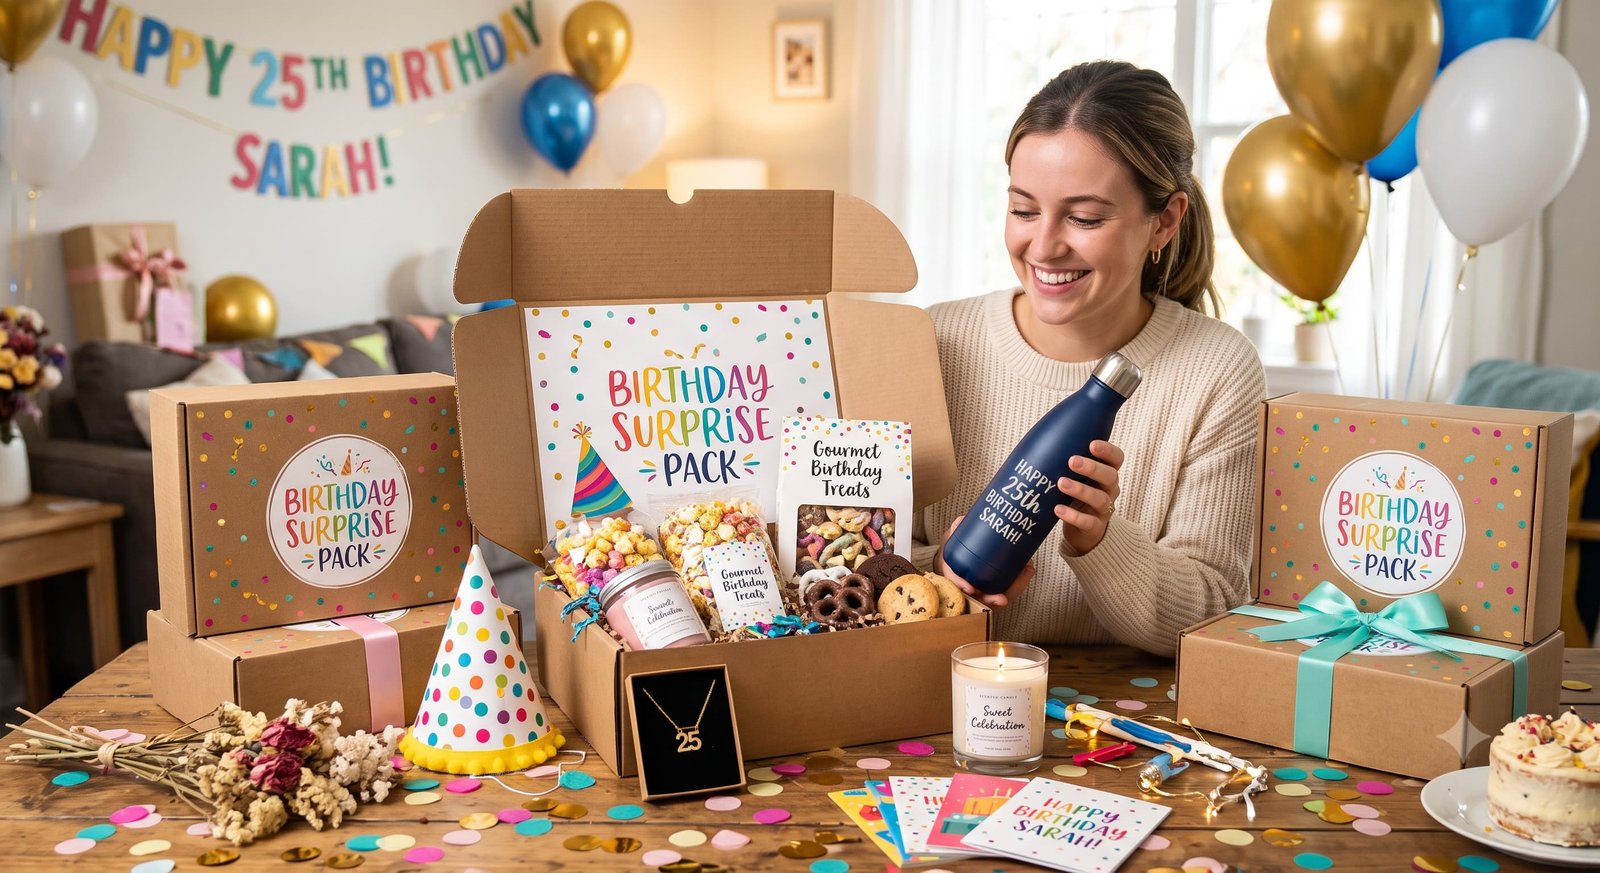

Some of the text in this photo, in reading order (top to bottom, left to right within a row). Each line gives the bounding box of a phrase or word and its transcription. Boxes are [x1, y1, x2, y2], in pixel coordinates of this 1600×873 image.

[57, 0, 543, 110] HAPPY 25TH BIRTHDAY
[230, 133, 396, 199] SARAH!
[608, 363, 774, 407] BIRTHDAY
[813, 439, 882, 460] Gourmet
[664, 449, 741, 487] PACK
[811, 460, 883, 485] Birthday
[1014, 458, 1056, 494] HAPPY
[284, 478, 400, 516] BIRTHDAY
[821, 479, 870, 499] Treats
[1001, 475, 1041, 514] 25th
[979, 506, 1023, 545] SARAH!
[985, 488, 1037, 535] BIRTHDAY,
[1338, 490, 1452, 530] BIRTHDAY
[318, 542, 371, 573] PACK
[721, 565, 765, 580] Gourmet
[1365, 552, 1417, 582] PACK
[722, 576, 769, 593] Birthday
[732, 588, 766, 602] Treats
[971, 716, 1025, 731] Celebration
[983, 704, 1013, 717] Sweet
[675, 730, 702, 753] 25
[1012, 804, 1128, 842] BIRTHDAY
[1043, 797, 1120, 824] HAPPY
[1013, 819, 1103, 851] SARAH!
